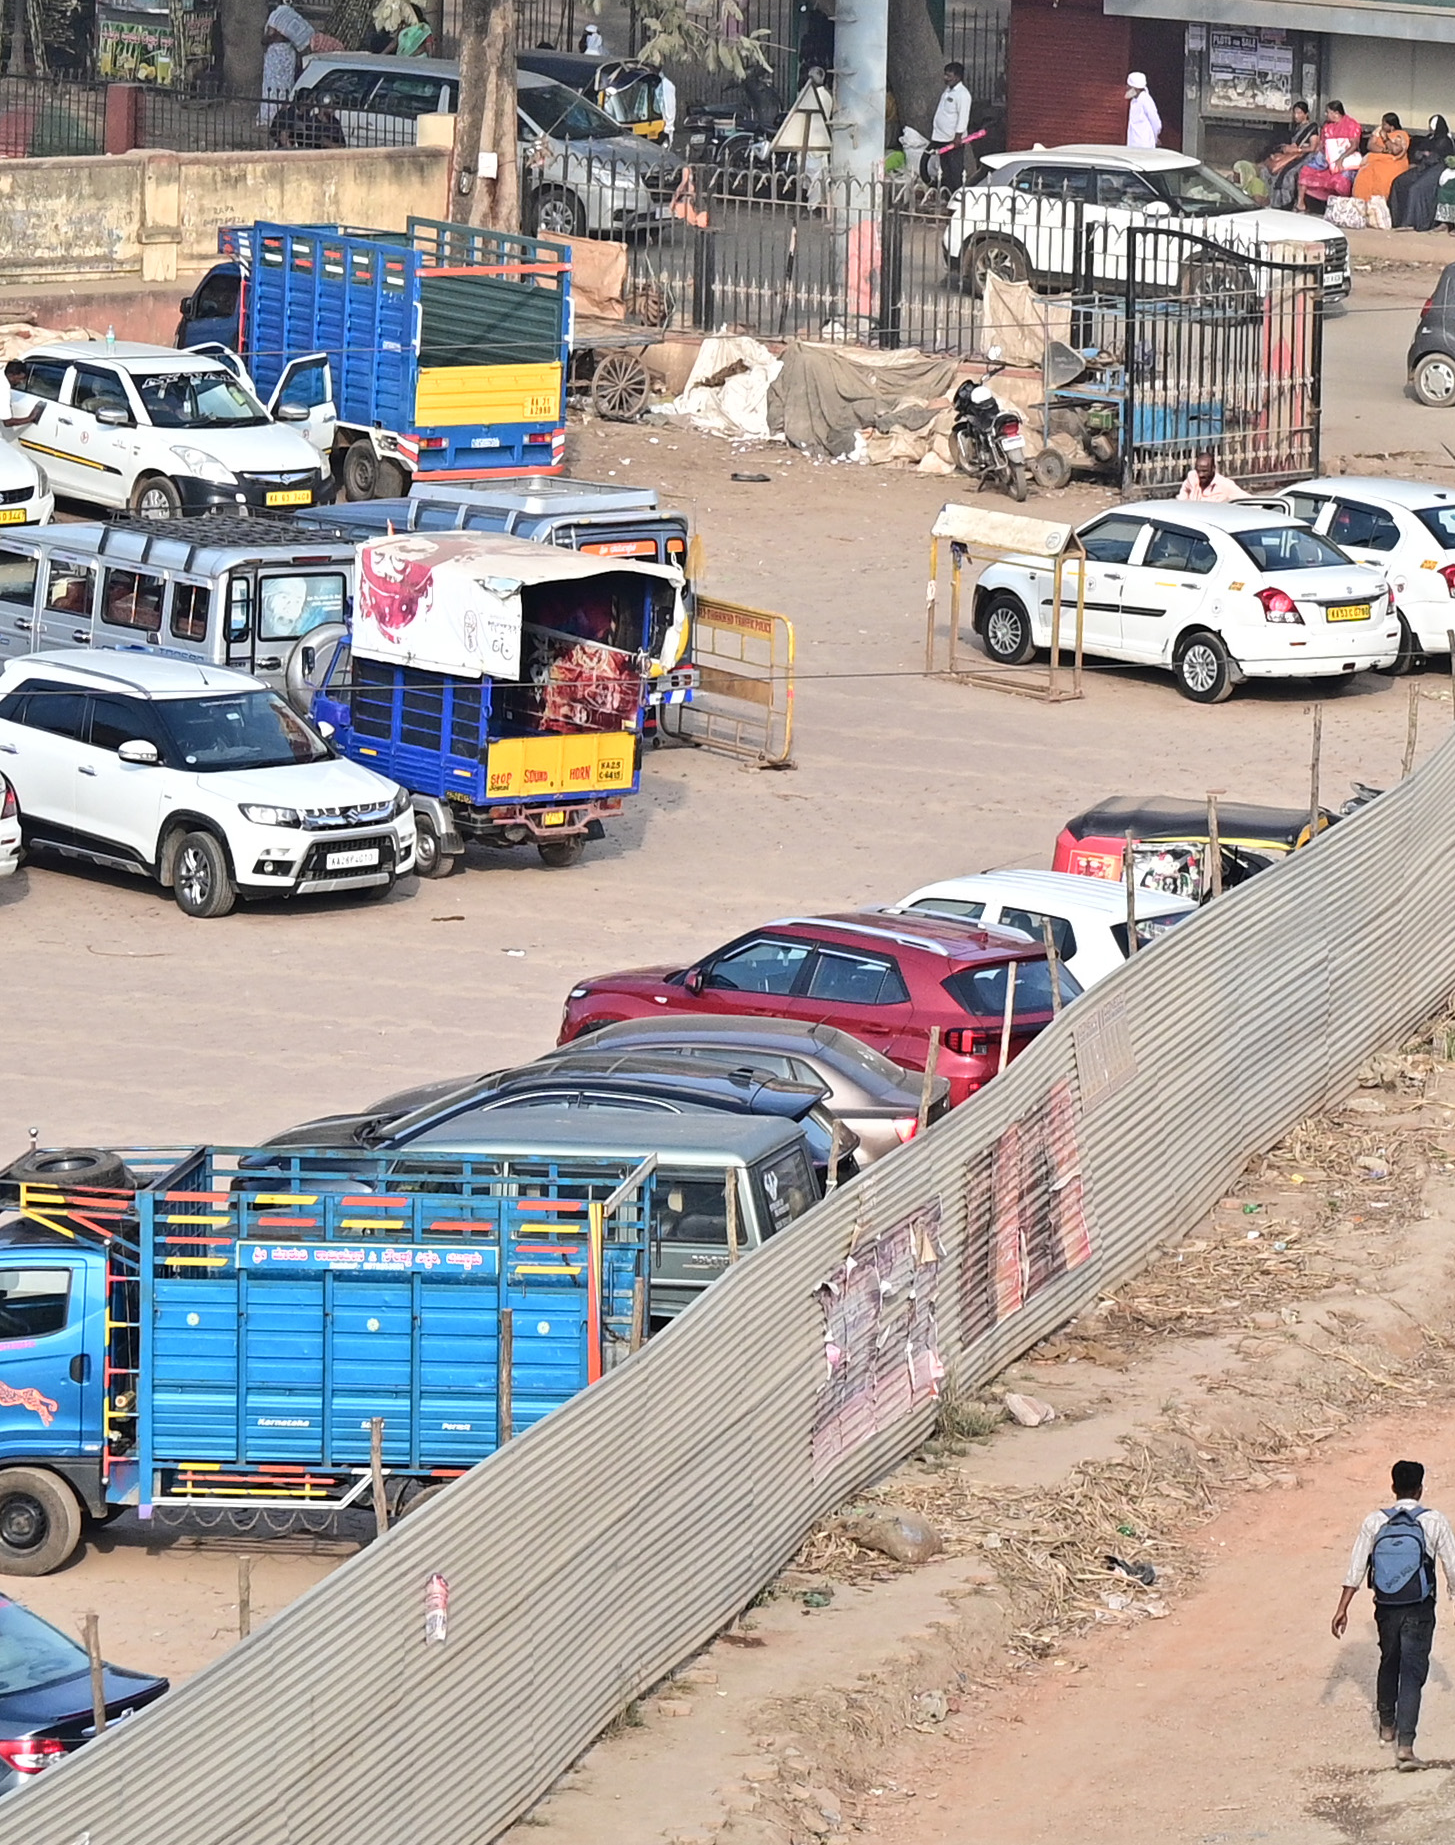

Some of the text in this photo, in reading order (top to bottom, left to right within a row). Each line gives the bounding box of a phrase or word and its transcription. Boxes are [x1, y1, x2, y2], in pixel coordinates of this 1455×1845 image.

[524, 769, 549, 783] SOUND
[569, 765, 592, 781] HORN
[257, 1417, 310, 1427] Karnataka
